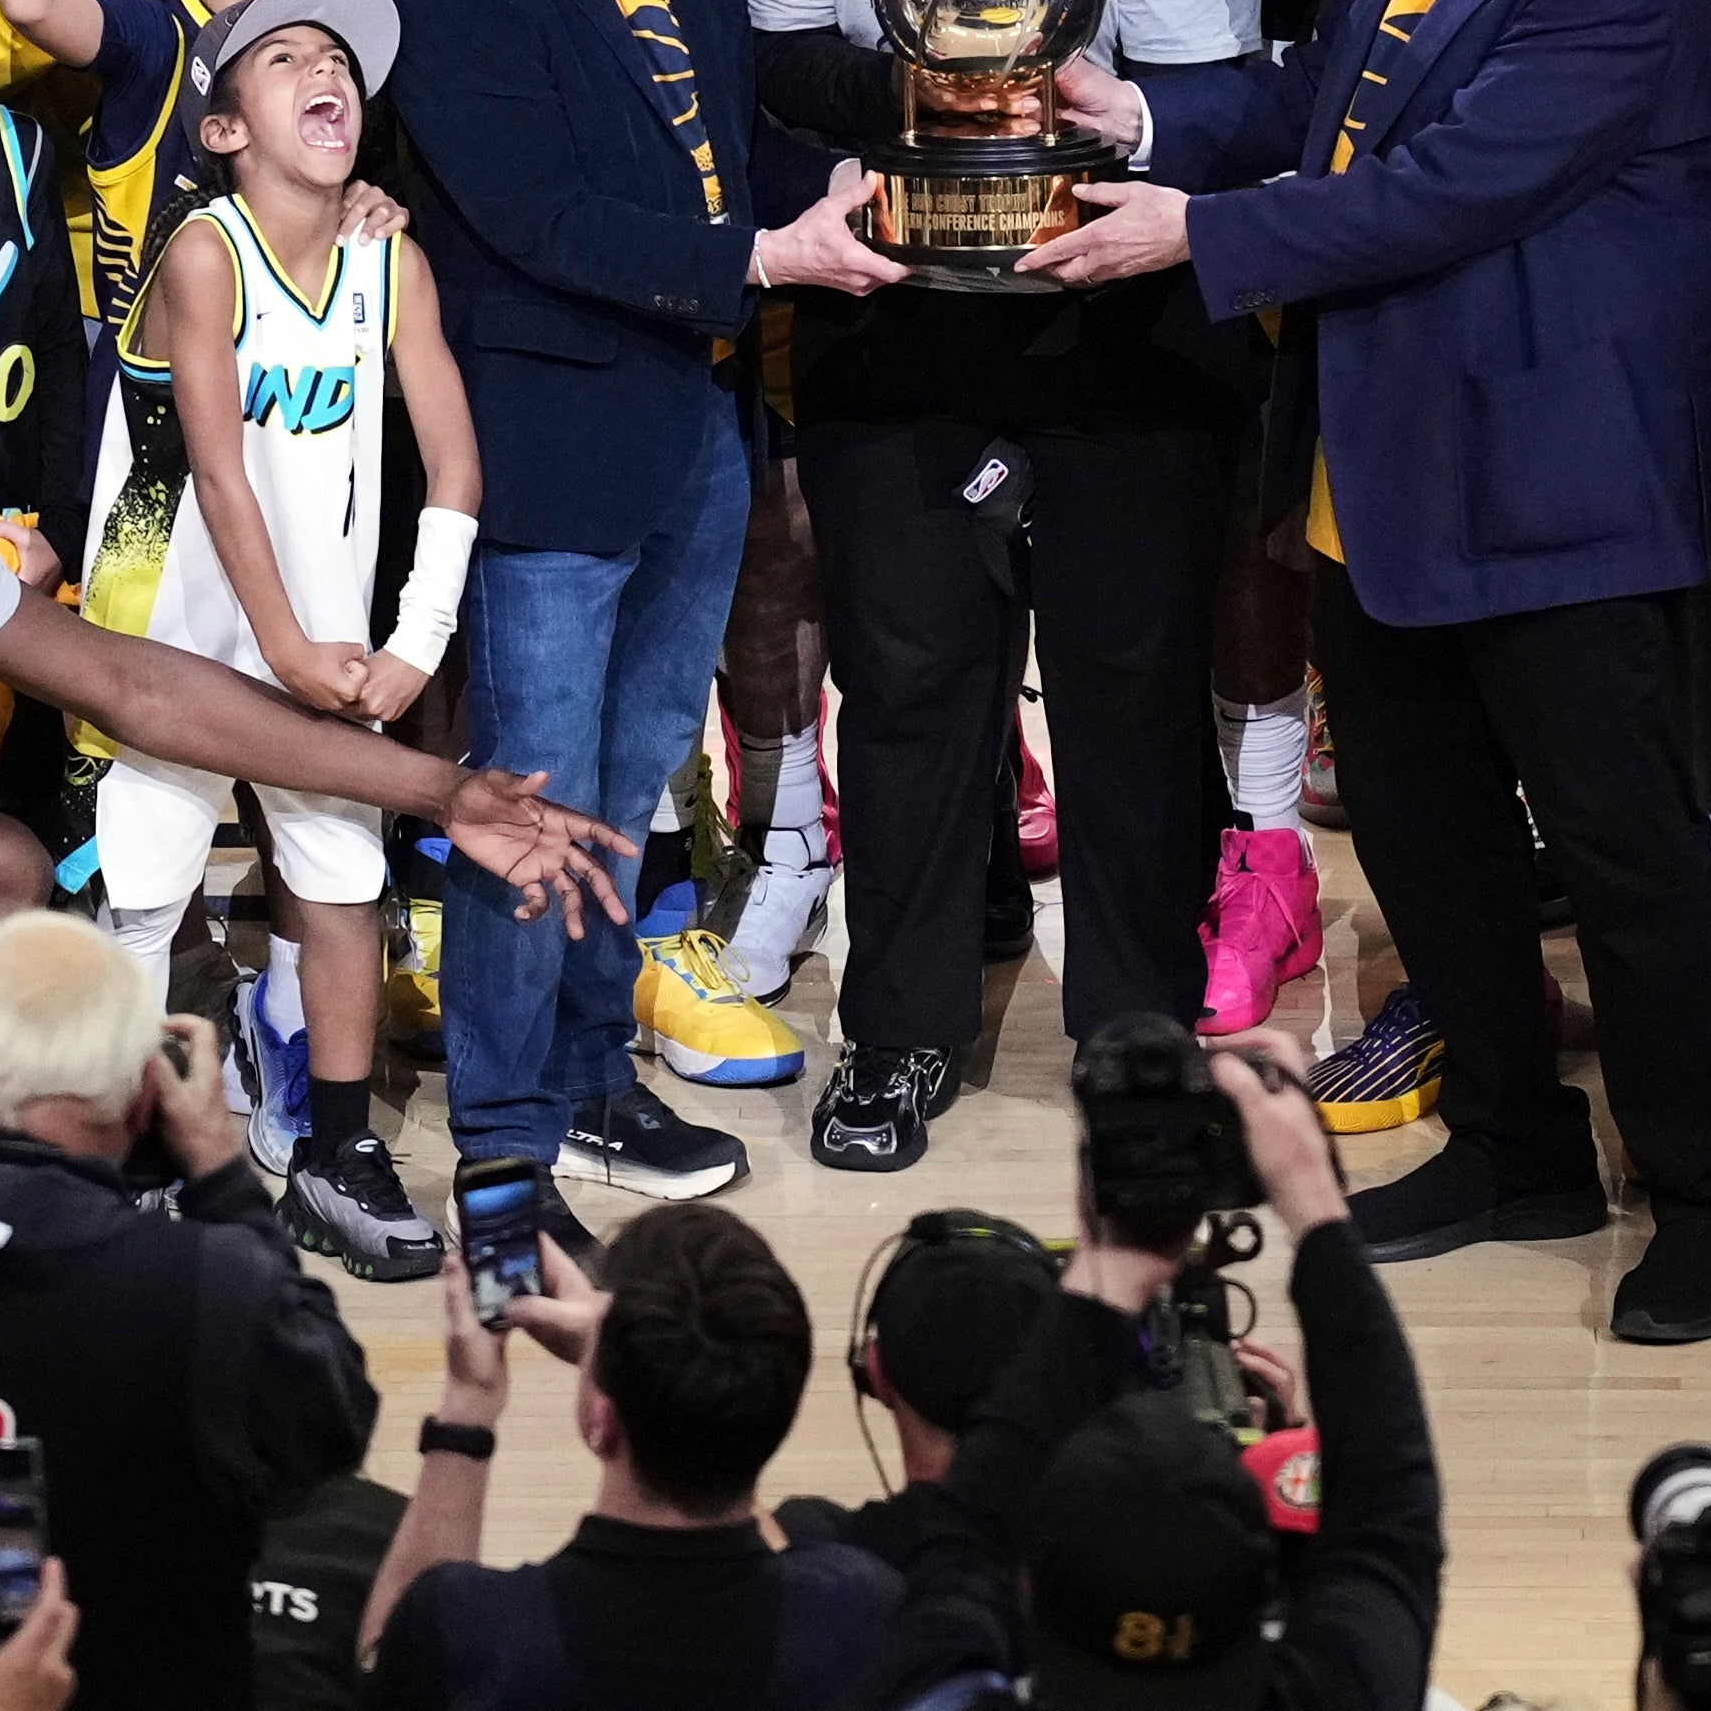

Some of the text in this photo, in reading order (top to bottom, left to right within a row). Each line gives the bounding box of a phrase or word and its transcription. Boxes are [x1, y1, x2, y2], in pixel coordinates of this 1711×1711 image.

[999, 210, 1065, 231] CHAMPIONS
[242, 362, 358, 435] IND
[566, 1129, 623, 1151] LTRA
